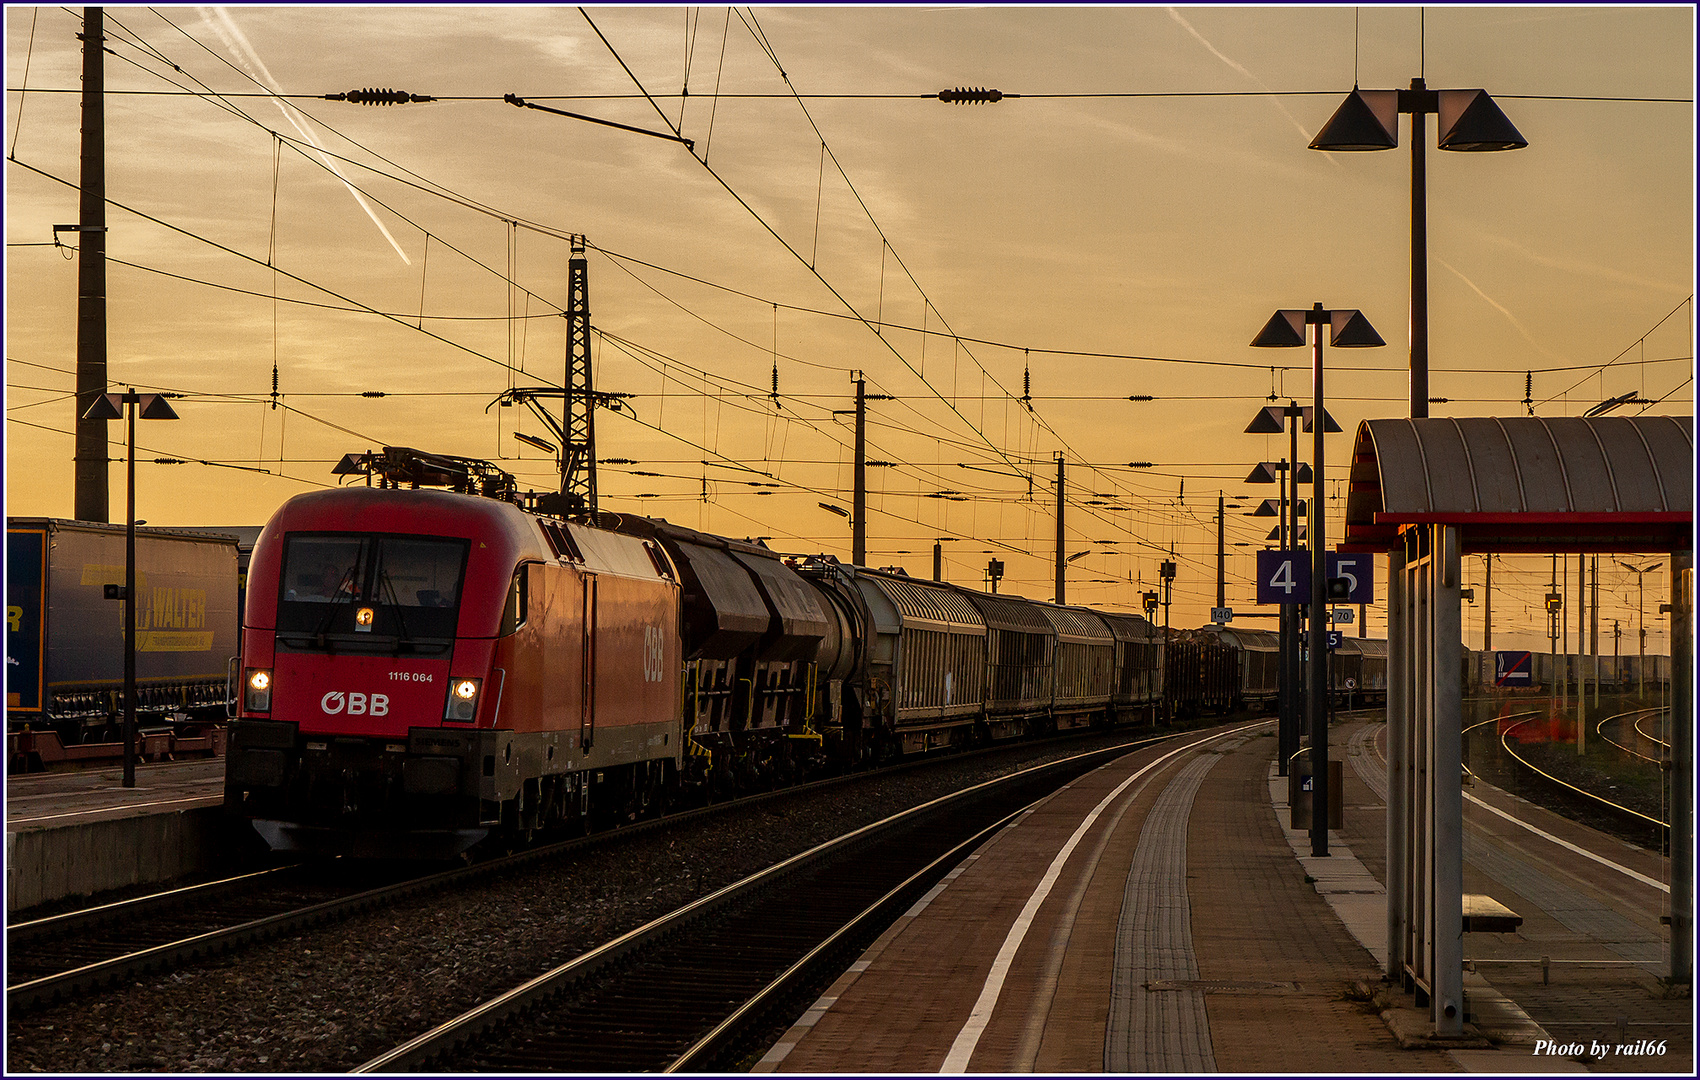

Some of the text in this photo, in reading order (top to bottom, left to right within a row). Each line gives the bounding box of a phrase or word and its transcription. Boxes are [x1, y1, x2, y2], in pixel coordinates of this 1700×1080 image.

[1269, 560, 1297, 594] 4
[1337, 560, 1358, 593] 5
[153, 586, 206, 628] WALTER
[1212, 610, 1230, 619] 140
[1337, 612, 1349, 621] 70
[1329, 634, 1338, 645] 5
[388, 671, 433, 683] 1116 064
[321, 691, 390, 717] ÖBB
[415, 736, 461, 748] SIEMENS
